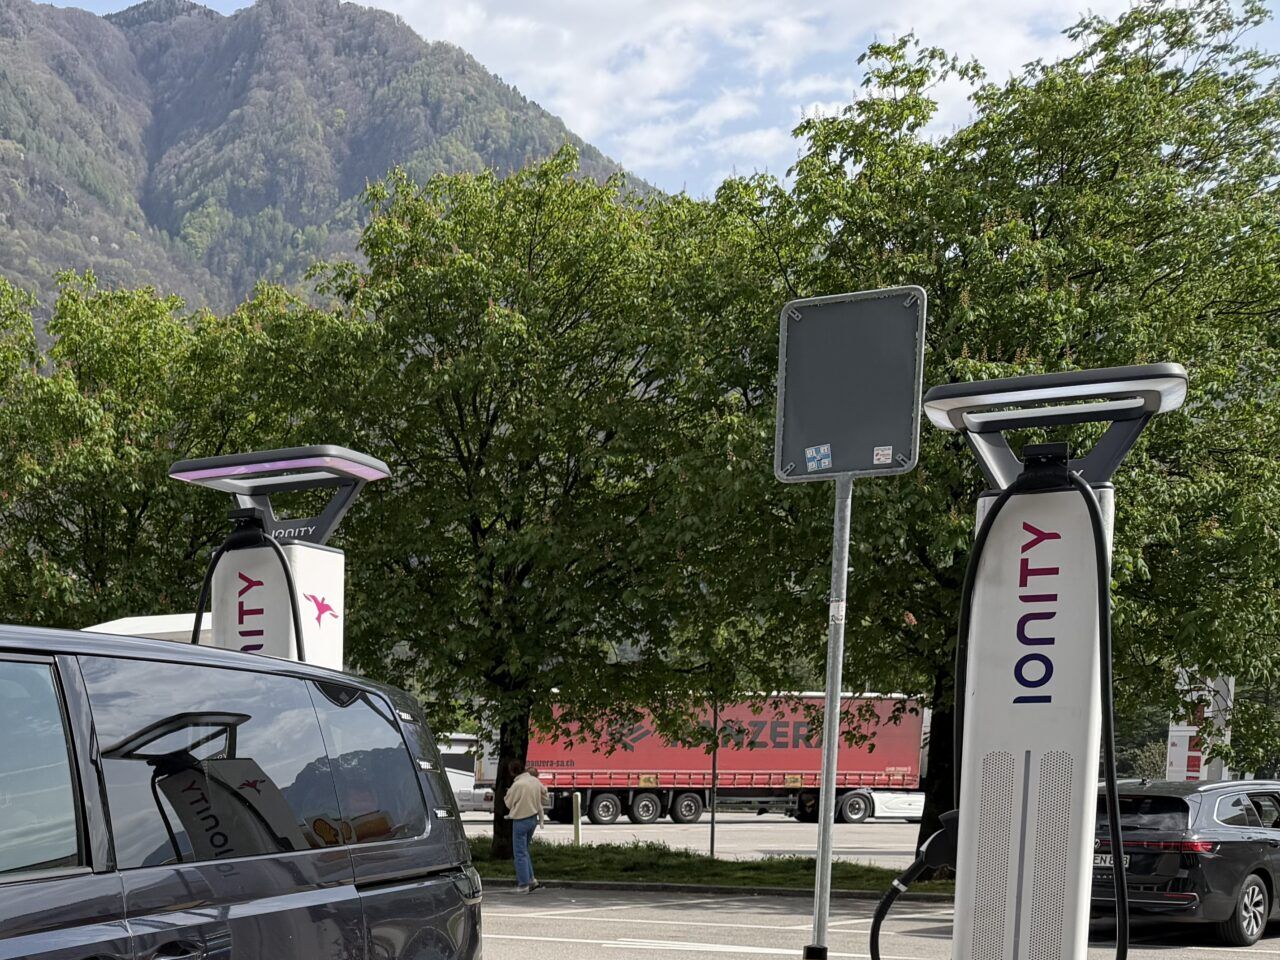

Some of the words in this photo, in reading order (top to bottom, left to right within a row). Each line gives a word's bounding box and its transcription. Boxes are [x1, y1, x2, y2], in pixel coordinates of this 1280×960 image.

[271, 526, 316, 538] IONITY
[238, 572, 264, 652] ITY
[1013, 521, 1062, 704] IONITY
